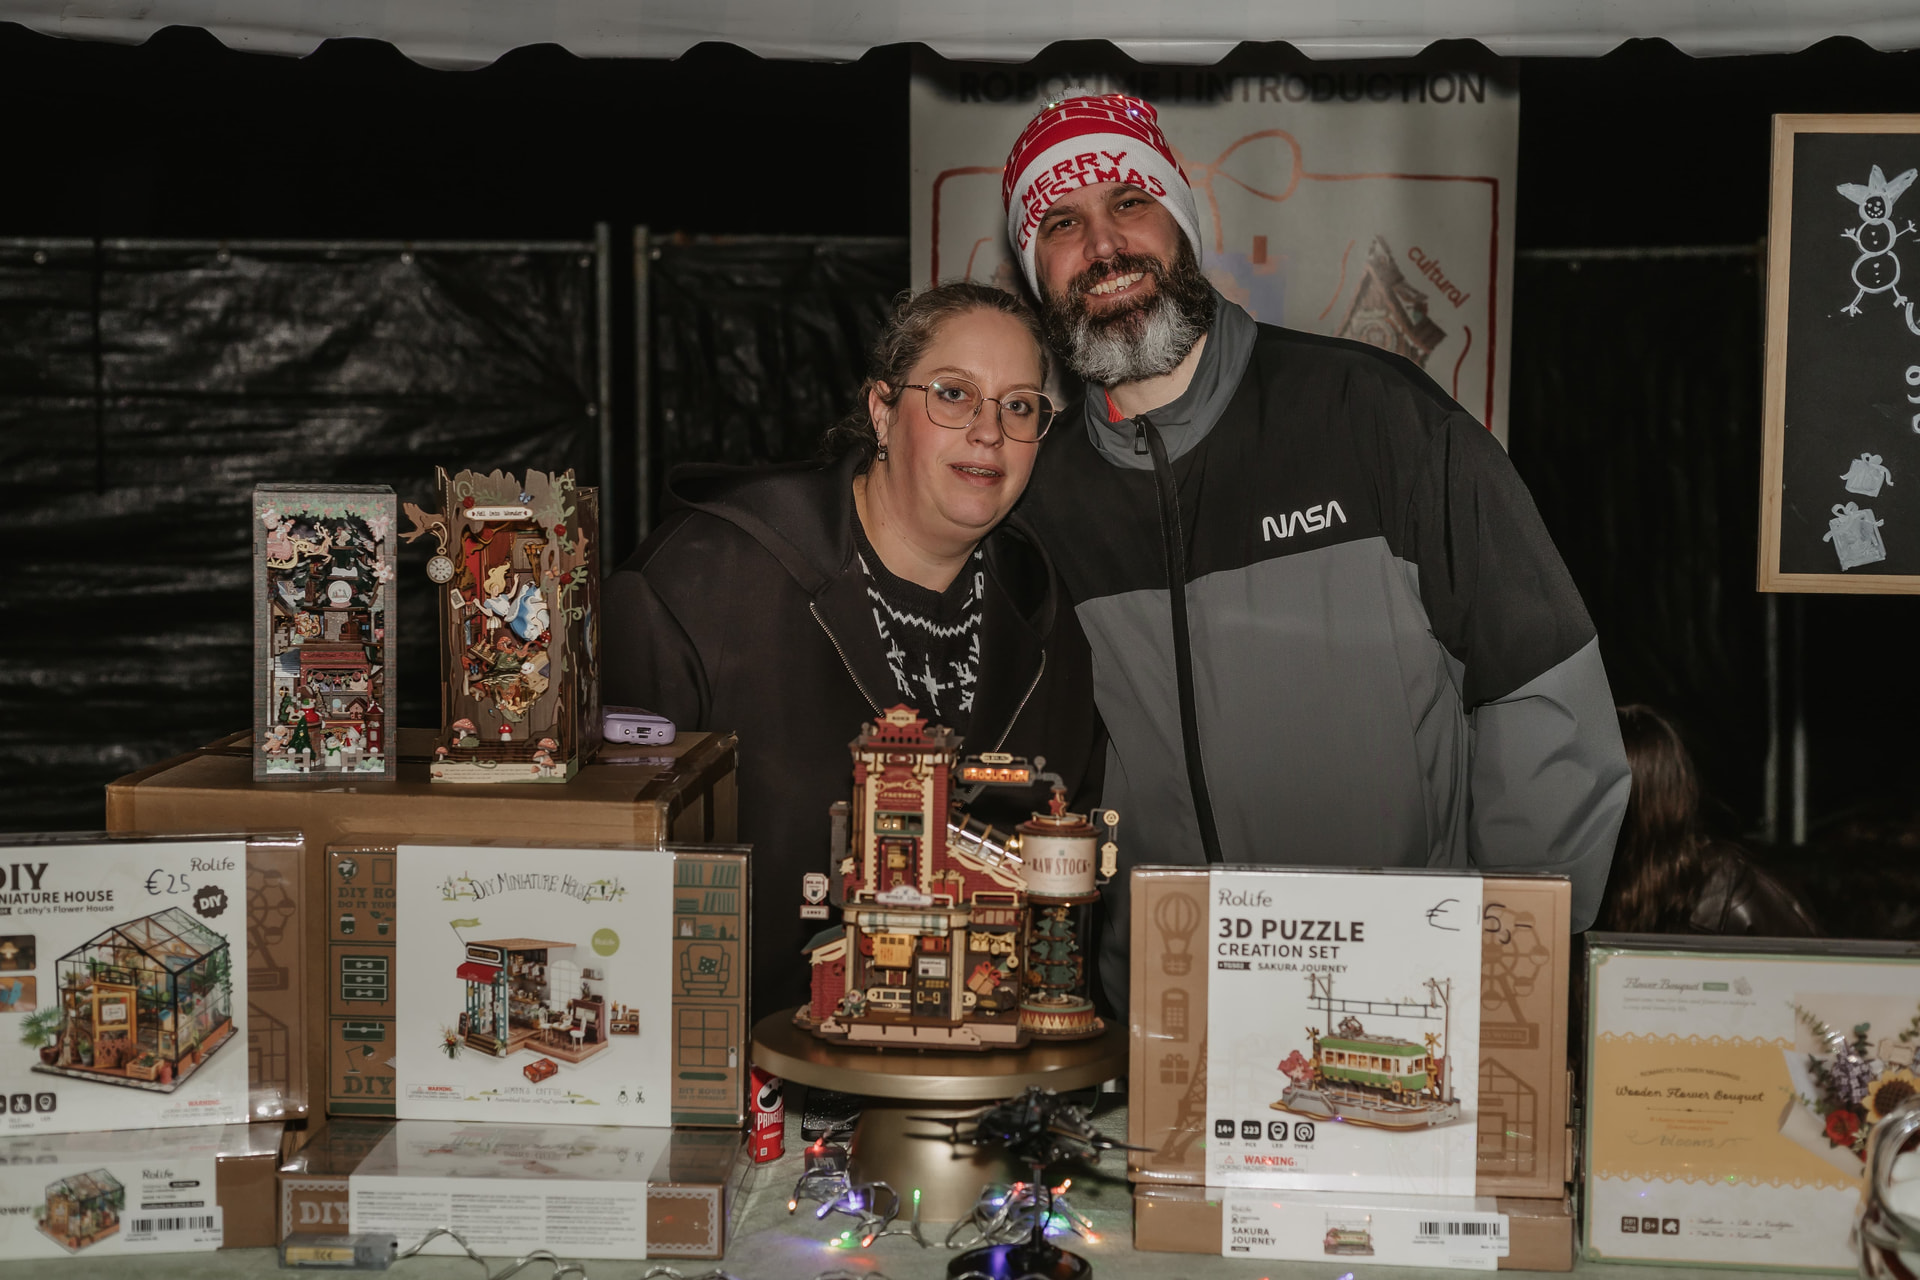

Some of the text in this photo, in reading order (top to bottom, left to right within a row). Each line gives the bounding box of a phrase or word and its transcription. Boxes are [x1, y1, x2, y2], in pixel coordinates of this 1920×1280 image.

[1196, 72, 1486, 104] INTRODUCTION
[1021, 150, 1128, 209] MERRY
[1017, 166, 1167, 251] CHRISTMAS
[1407, 246, 1471, 309] cultural
[1261, 500, 1348, 542] NASA
[963, 767, 1029, 783] PRODUCTION
[190, 856, 236, 872] Rolife
[1032, 857, 1088, 876] RAW STOCK
[0, 862, 49, 891] IY
[144, 868, 191, 896] €25
[64, 889, 114, 903] HOUSE
[337, 887, 368, 898] DIY
[1217, 888, 1273, 908] Rolife
[17, 906, 51, 916] Cathy's
[53, 905, 84, 913] Flower
[86, 904, 115, 913] House
[199, 894, 222, 910] DIY
[338, 901, 354, 909] DO
[356, 901, 369, 909] IT
[1218, 917, 1365, 943] 3D PUZZLE
[1217, 942, 1341, 959] CREATION SET
[1257, 962, 1299, 972] SAKURA
[1300, 963, 1349, 974] JOURNEY
[343, 1075, 396, 1095] DIY
[1615, 1085, 1765, 1105] Wooden Flower Bouquet
[1217, 1125, 1233, 1134] 14+
[1243, 1126, 1260, 1135] 223
[300, 1201, 350, 1225] DIY
[1231, 1226, 1270, 1236] SAKURA
[1644, 1221, 1657, 1231] 8+
[1231, 1236, 1277, 1246] JOURNEY
